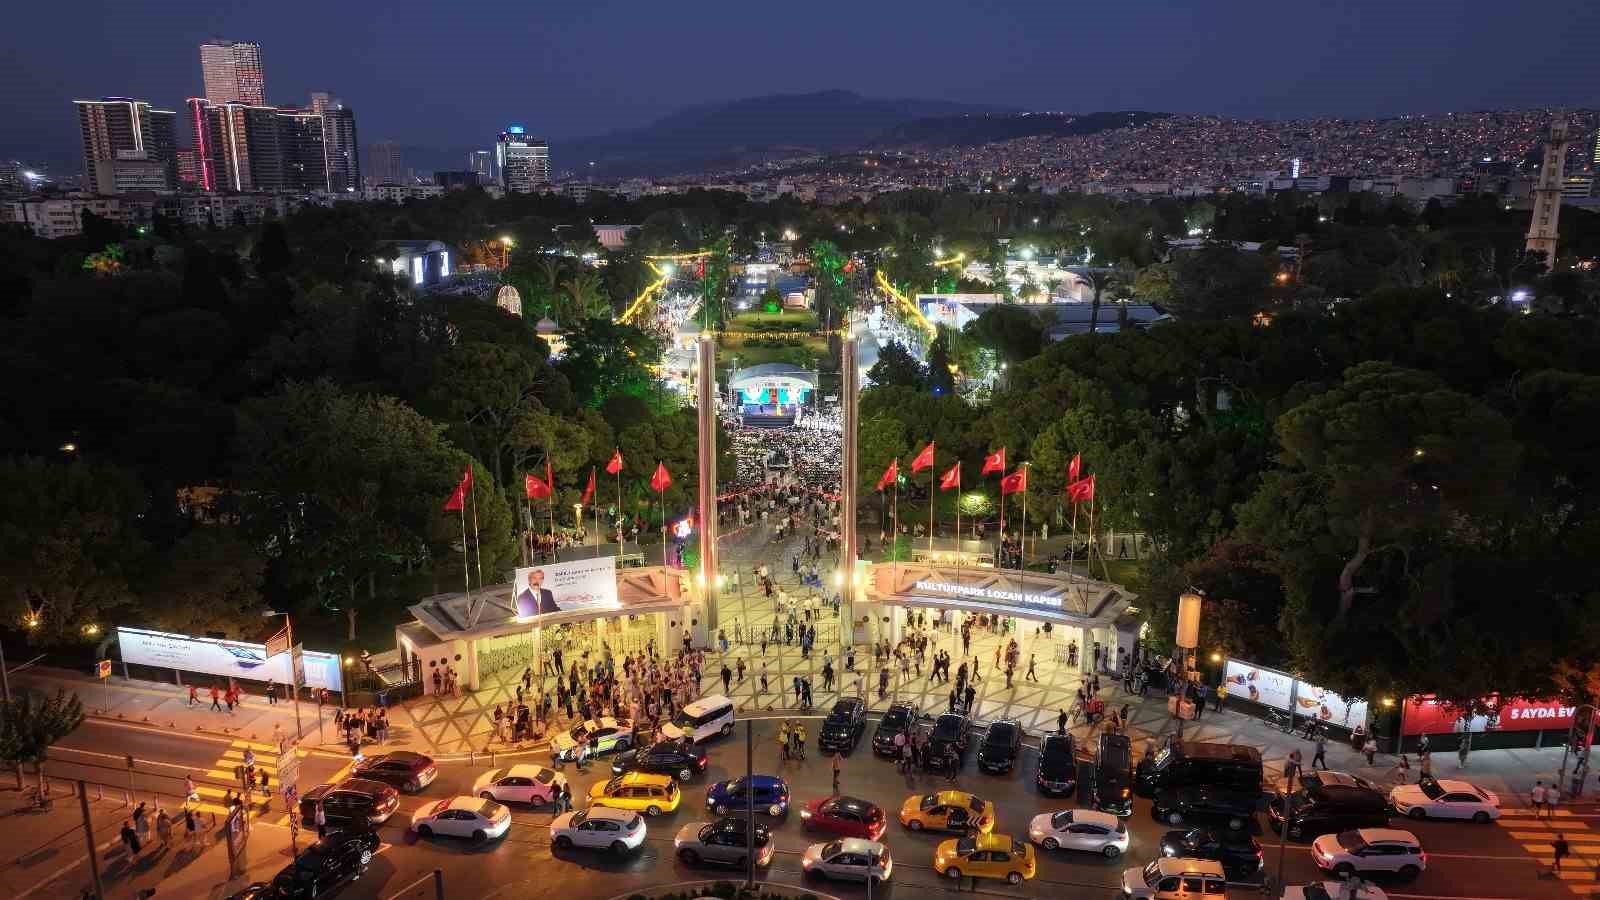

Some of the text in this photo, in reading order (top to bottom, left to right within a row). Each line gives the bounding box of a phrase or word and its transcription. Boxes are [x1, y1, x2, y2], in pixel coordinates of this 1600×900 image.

[987, 588, 1022, 602] LOZAN
[1024, 593, 1063, 607] KAPISI
[1511, 708, 1520, 720] 5
[1520, 707, 1556, 719] AYDA
